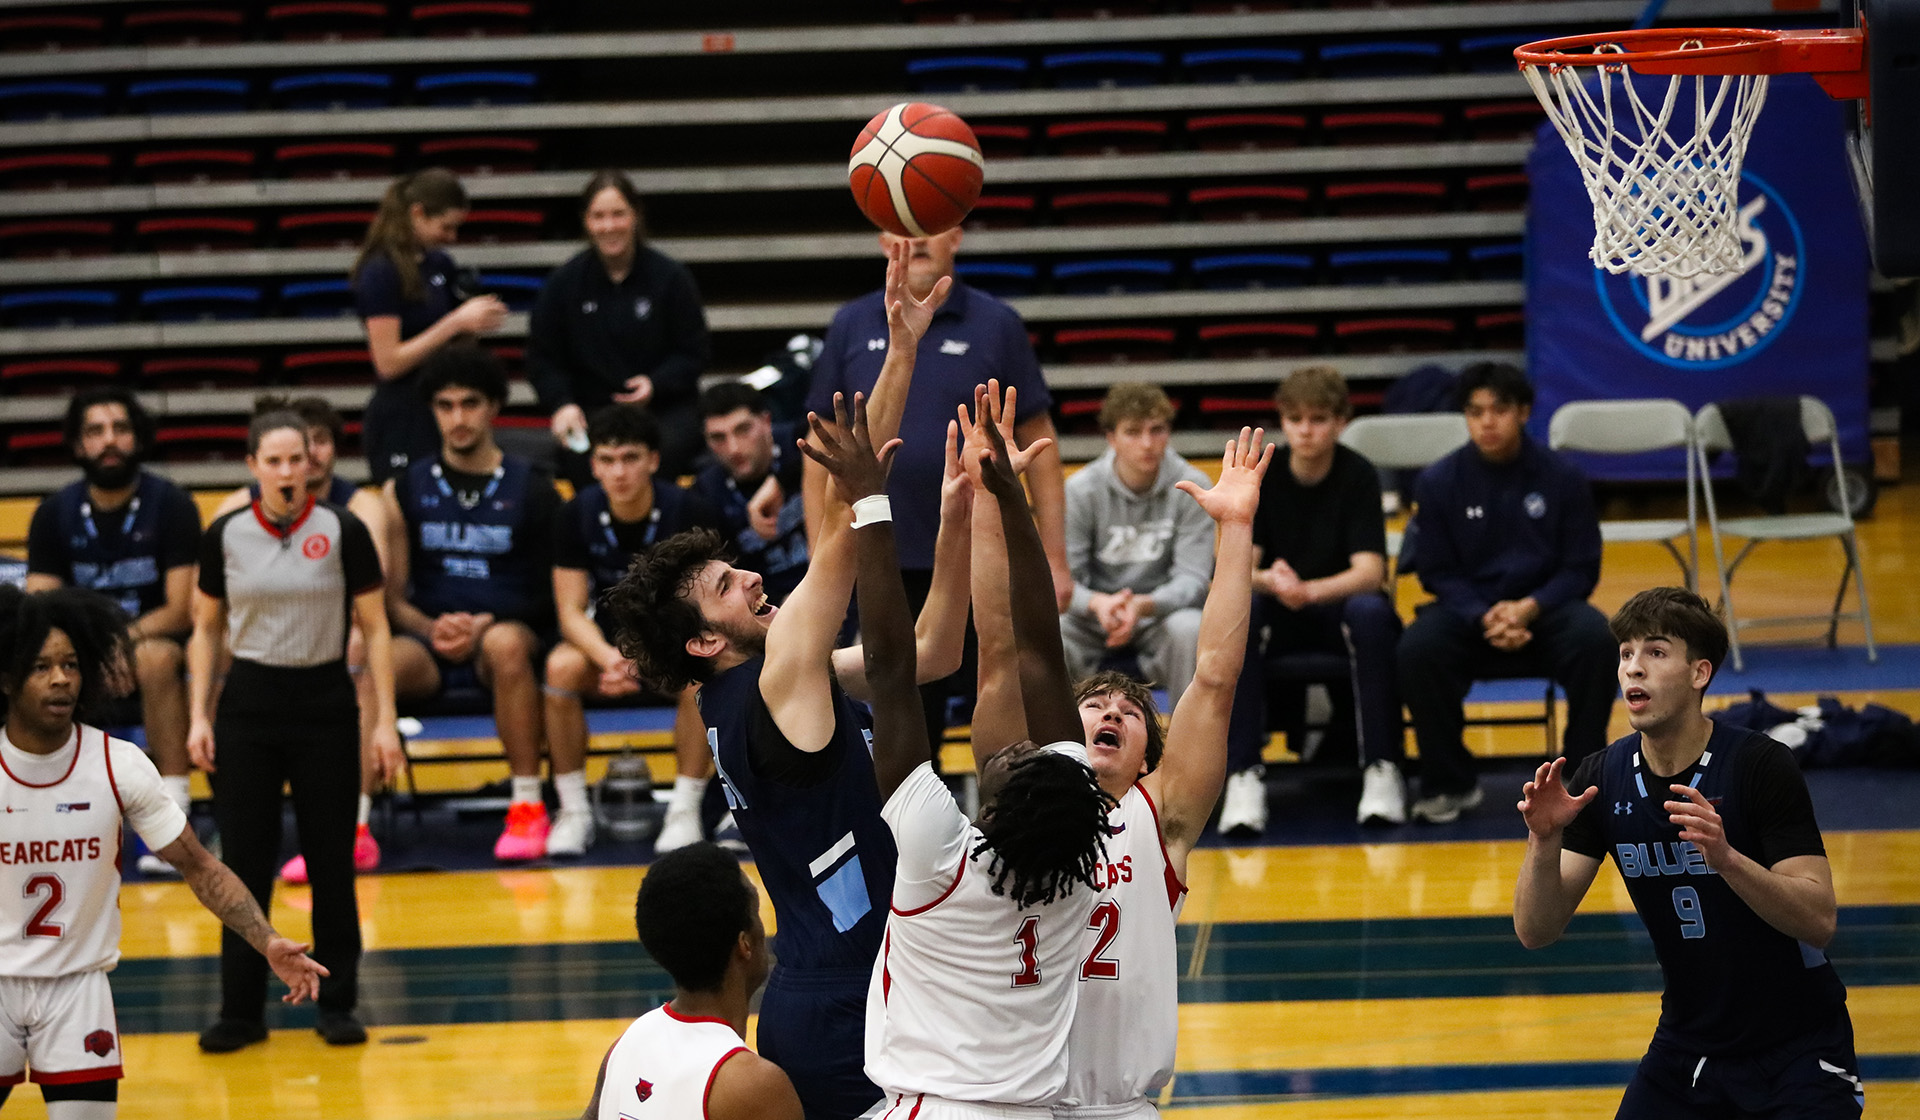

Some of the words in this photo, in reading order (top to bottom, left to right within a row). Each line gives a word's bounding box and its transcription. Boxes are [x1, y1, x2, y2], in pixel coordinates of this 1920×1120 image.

[1664, 253, 1797, 361] UNIVERSITY
[0, 837, 100, 865] EARCATS
[1616, 841, 1719, 878] BLUE
[23, 871, 66, 940] 2
[1672, 885, 1706, 940] 9
[1011, 915, 1042, 988] 1
